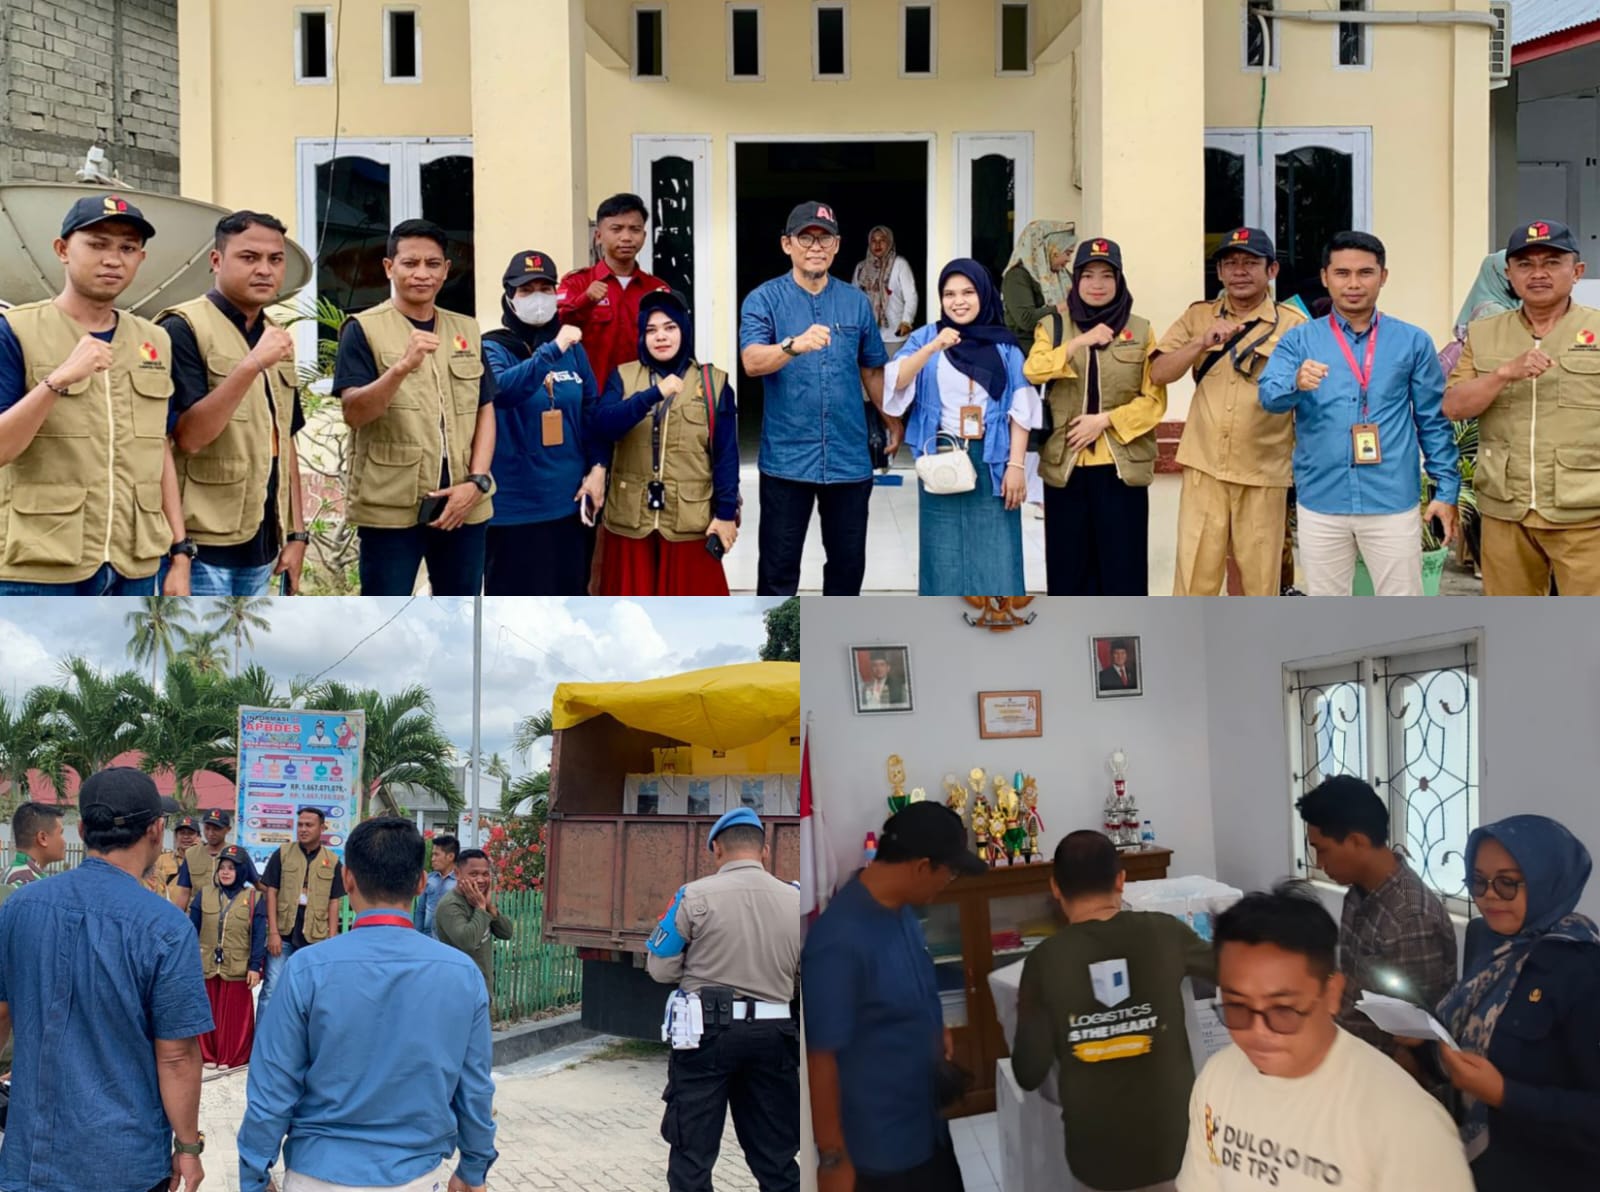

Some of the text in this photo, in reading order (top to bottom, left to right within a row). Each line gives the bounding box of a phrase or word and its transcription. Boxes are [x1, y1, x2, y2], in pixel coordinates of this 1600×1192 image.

[246, 722, 301, 733] APBDES
[1069, 1003, 1153, 1027] LOGISTICS
[1109, 1016, 1159, 1036] HEART
[1222, 1147, 1280, 1187] DE TPS
